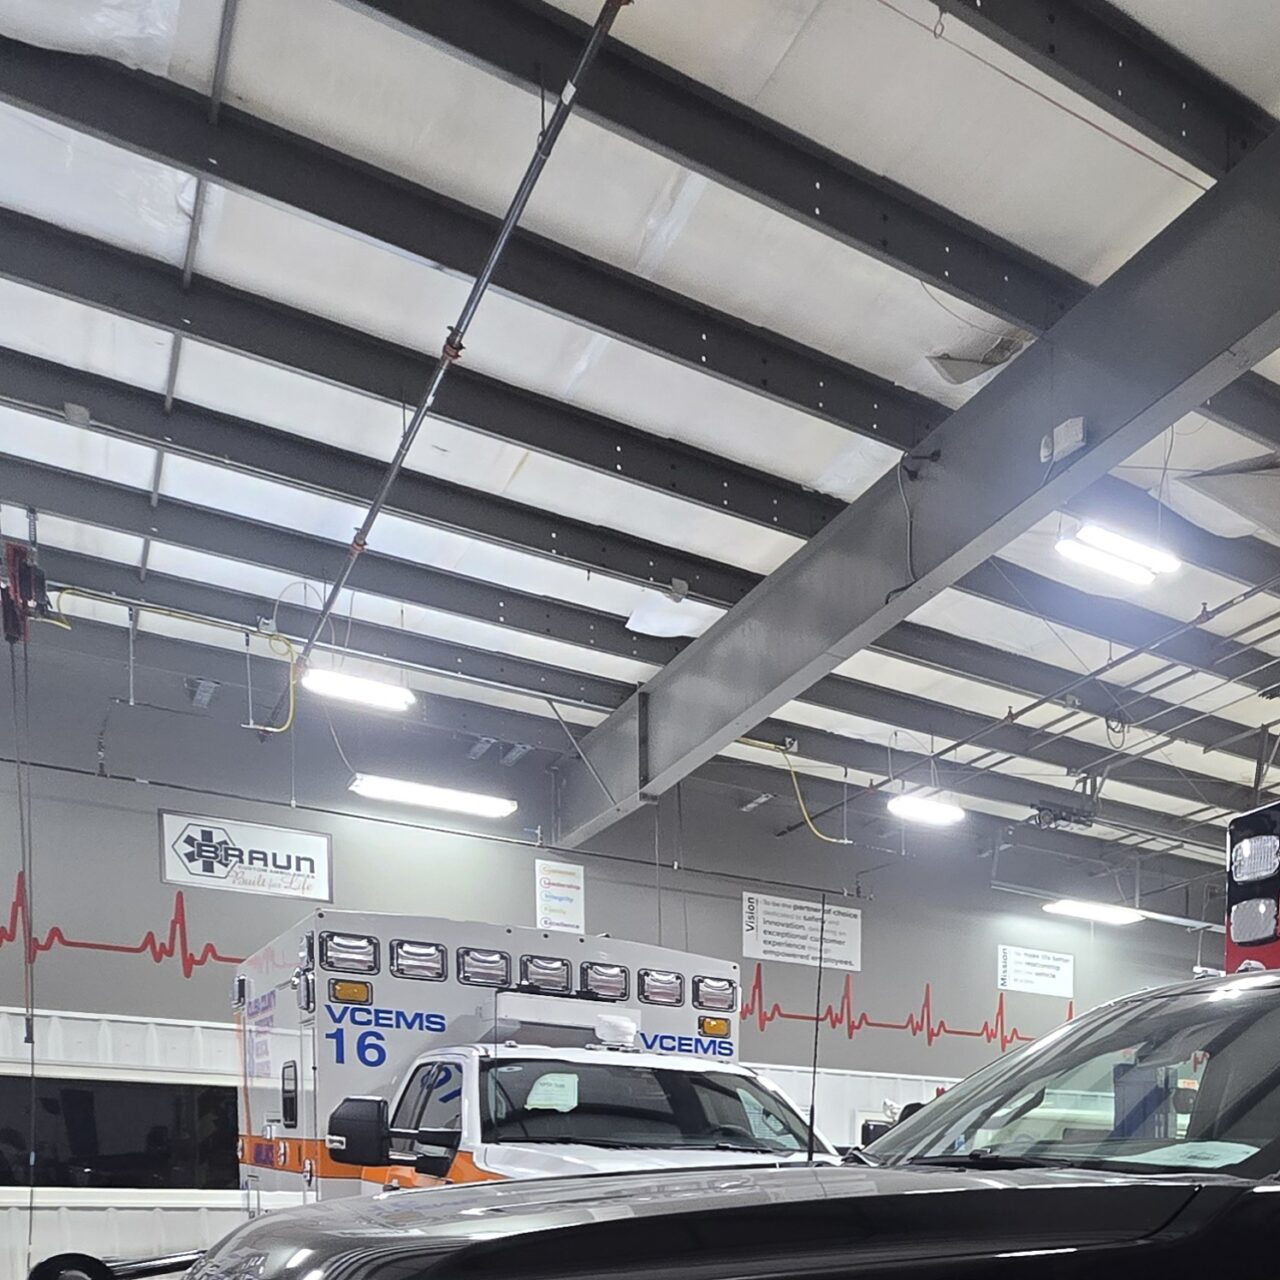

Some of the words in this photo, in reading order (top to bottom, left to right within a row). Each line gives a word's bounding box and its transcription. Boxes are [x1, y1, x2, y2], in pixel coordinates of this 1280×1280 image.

[745, 896, 755, 932] Vision
[832, 910, 858, 919] choice
[762, 929, 809, 940] exceptional
[762, 939, 806, 951] experience
[762, 949, 810, 960] empowered
[1000, 947, 1008, 987] Mission
[324, 1004, 446, 1033] VCEMS
[325, 1027, 386, 1068] 16
[640, 1032, 734, 1057] VCEMS
